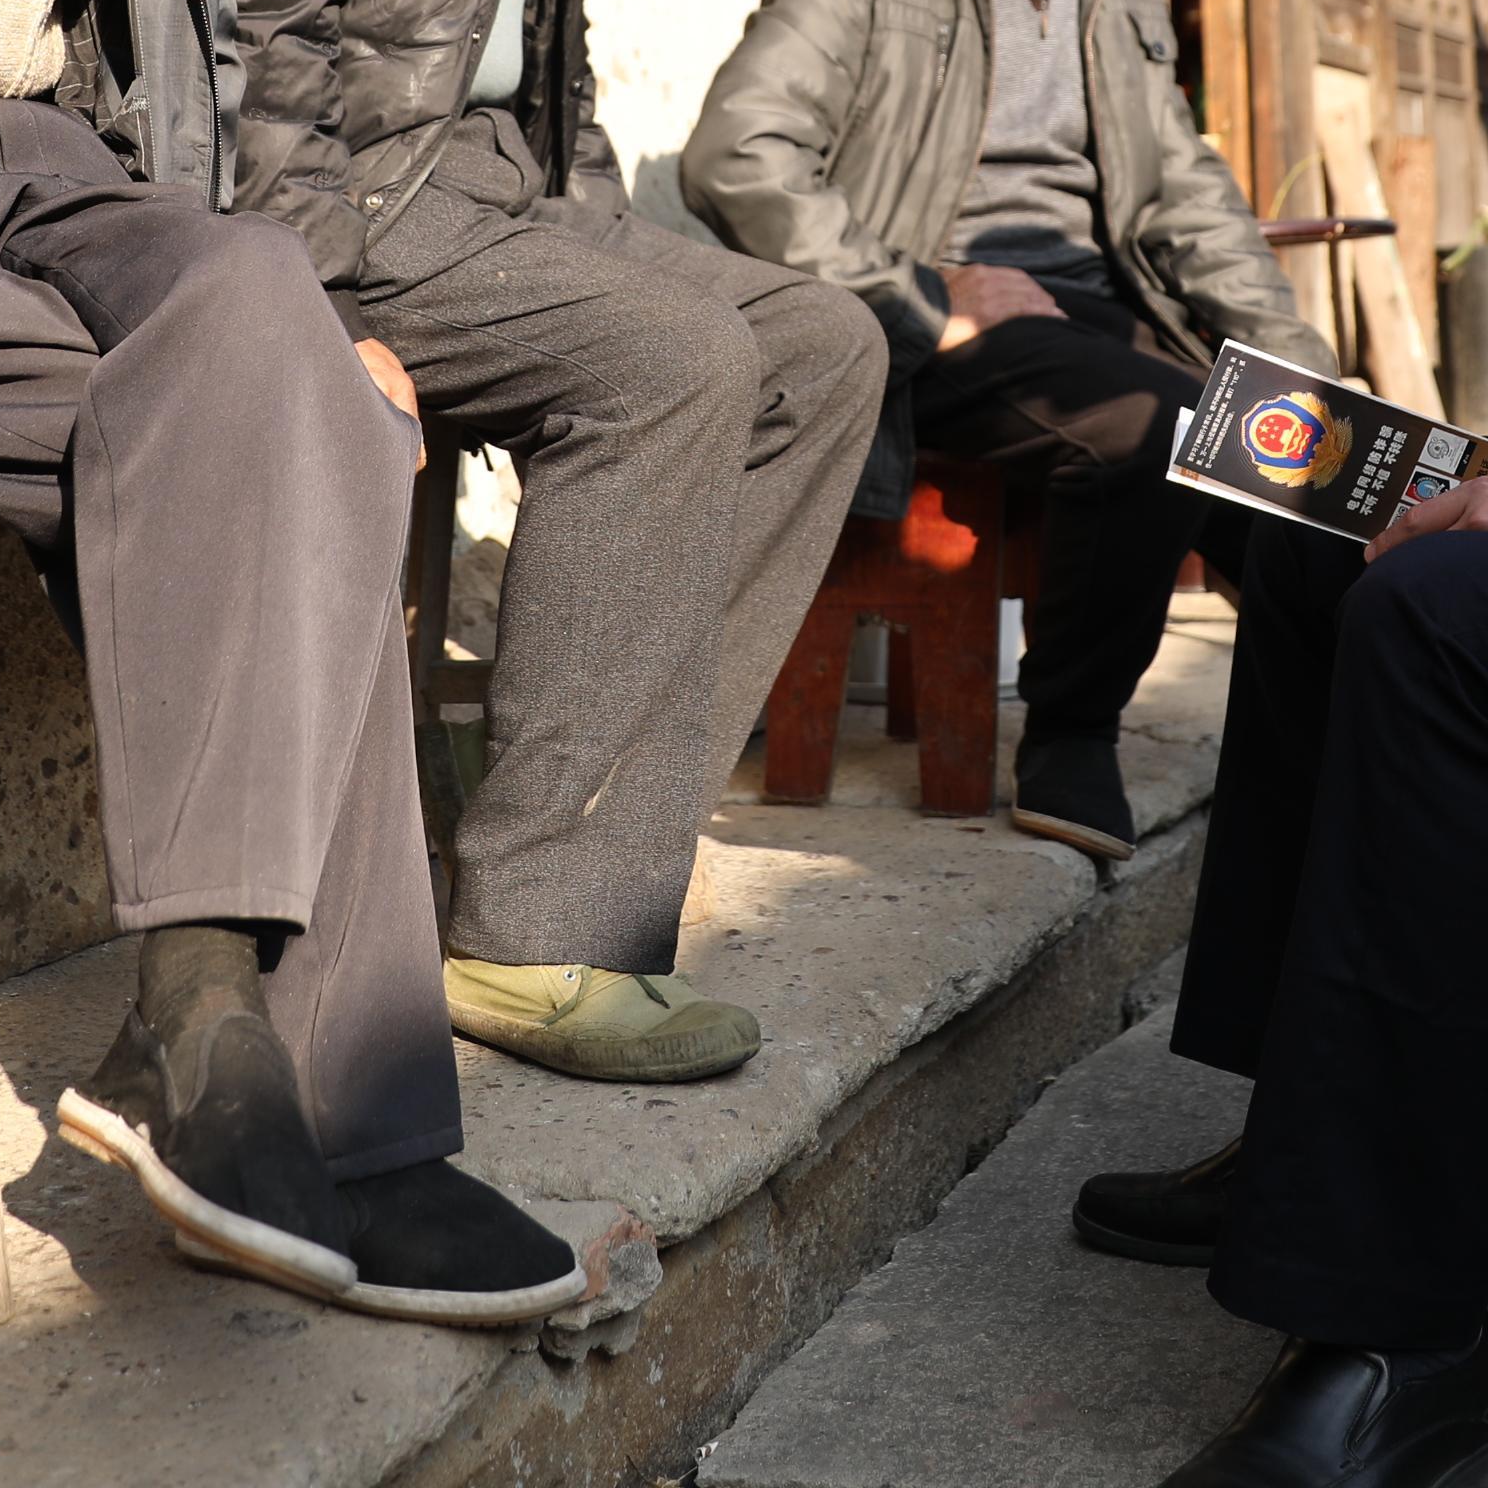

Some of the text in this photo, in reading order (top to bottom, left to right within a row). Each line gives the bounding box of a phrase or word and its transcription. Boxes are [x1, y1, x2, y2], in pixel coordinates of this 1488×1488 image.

[1346, 425, 1394, 511] 电信网络防诈骗
